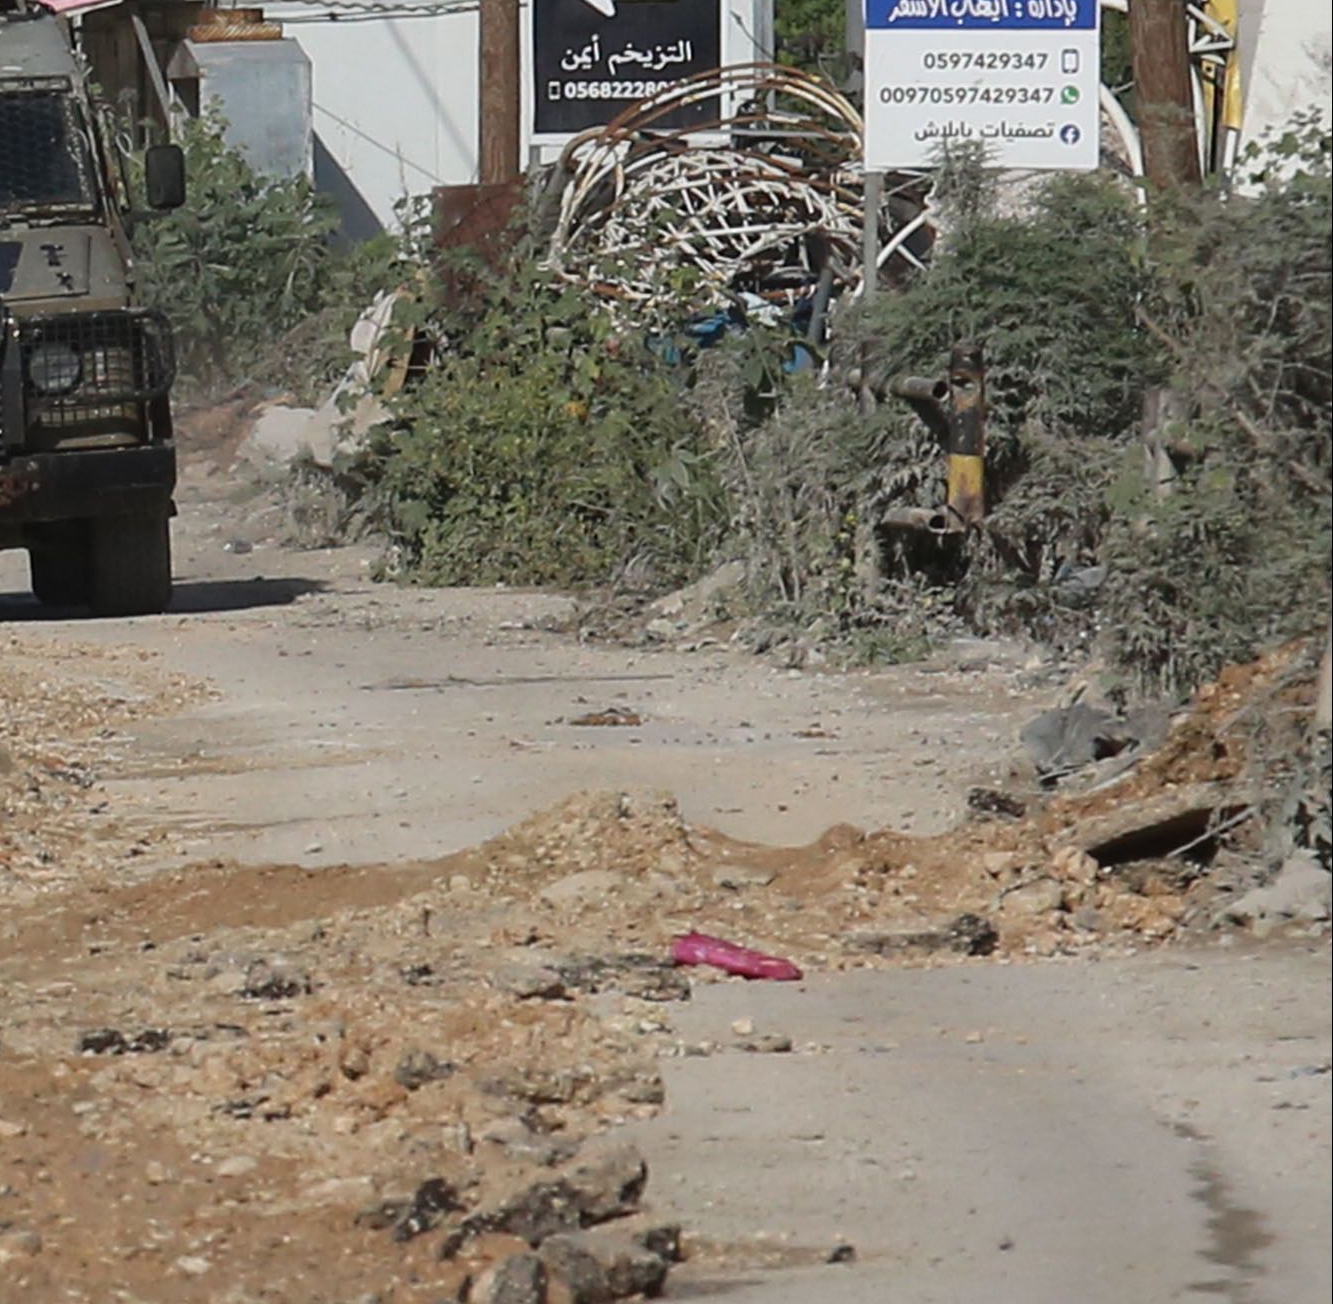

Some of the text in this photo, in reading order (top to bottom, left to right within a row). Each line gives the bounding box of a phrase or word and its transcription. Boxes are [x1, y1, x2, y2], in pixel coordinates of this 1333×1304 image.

[923, 52, 1049, 70] 0597429347
[564, 80, 676, 98] 05682228
[880, 87, 1055, 105] 00970597429347
[980, 120, 1056, 142] تصفيات
